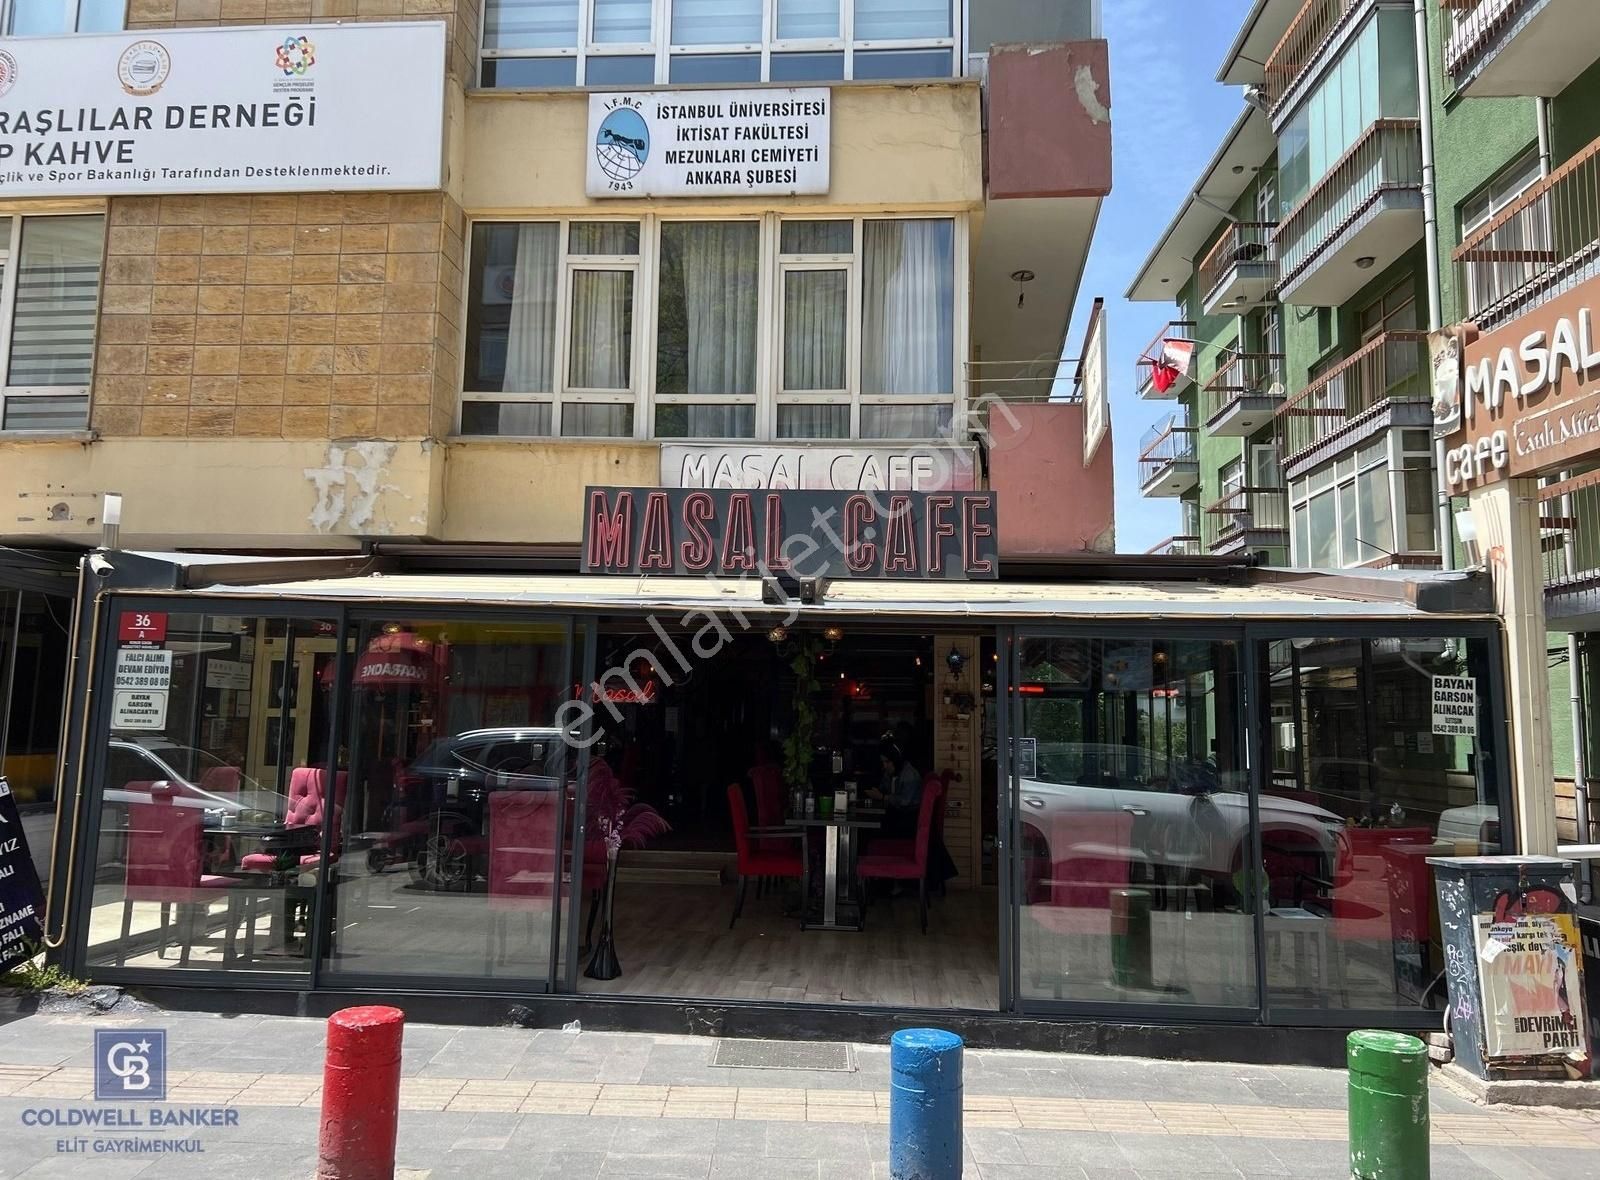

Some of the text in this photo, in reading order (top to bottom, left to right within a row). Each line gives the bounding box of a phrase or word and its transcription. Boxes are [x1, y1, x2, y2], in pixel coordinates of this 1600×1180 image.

[165, 96, 316, 130] DERNEĞİ
[656, 98, 826, 120] İSTANBUL ÜNİVERSİTESİ
[676, 122, 809, 142] İKTİSAT FAKÜLTESİ
[25, 140, 135, 166] KAHVE
[665, 145, 819, 165] MEZUNLARI CEMİYETİ
[28, 173, 44, 181] ve
[49, 170, 83, 183] Spor
[87, 167, 156, 182] Bakanlığı
[161, 166, 240, 180] Tarafından
[245, 163, 391, 178] Desteklenmektedir.
[685, 166, 797, 188] ANKARA ŞUBESİ
[607, 180, 634, 191] 1943
[1465, 308, 1600, 420] MASAL
[588, 491, 993, 573] MASAL CAFE
[135, 614, 151, 626] 36
[139, 630, 145, 638] A
[125, 653, 144, 661] FALCI
[118, 665, 143, 673] DEVAM
[116, 677, 133, 685] 0542
[1434, 678, 1473, 690] BAYAN
[1434, 691, 1473, 703] GARSON
[1433, 704, 1474, 716] ALINACAK
